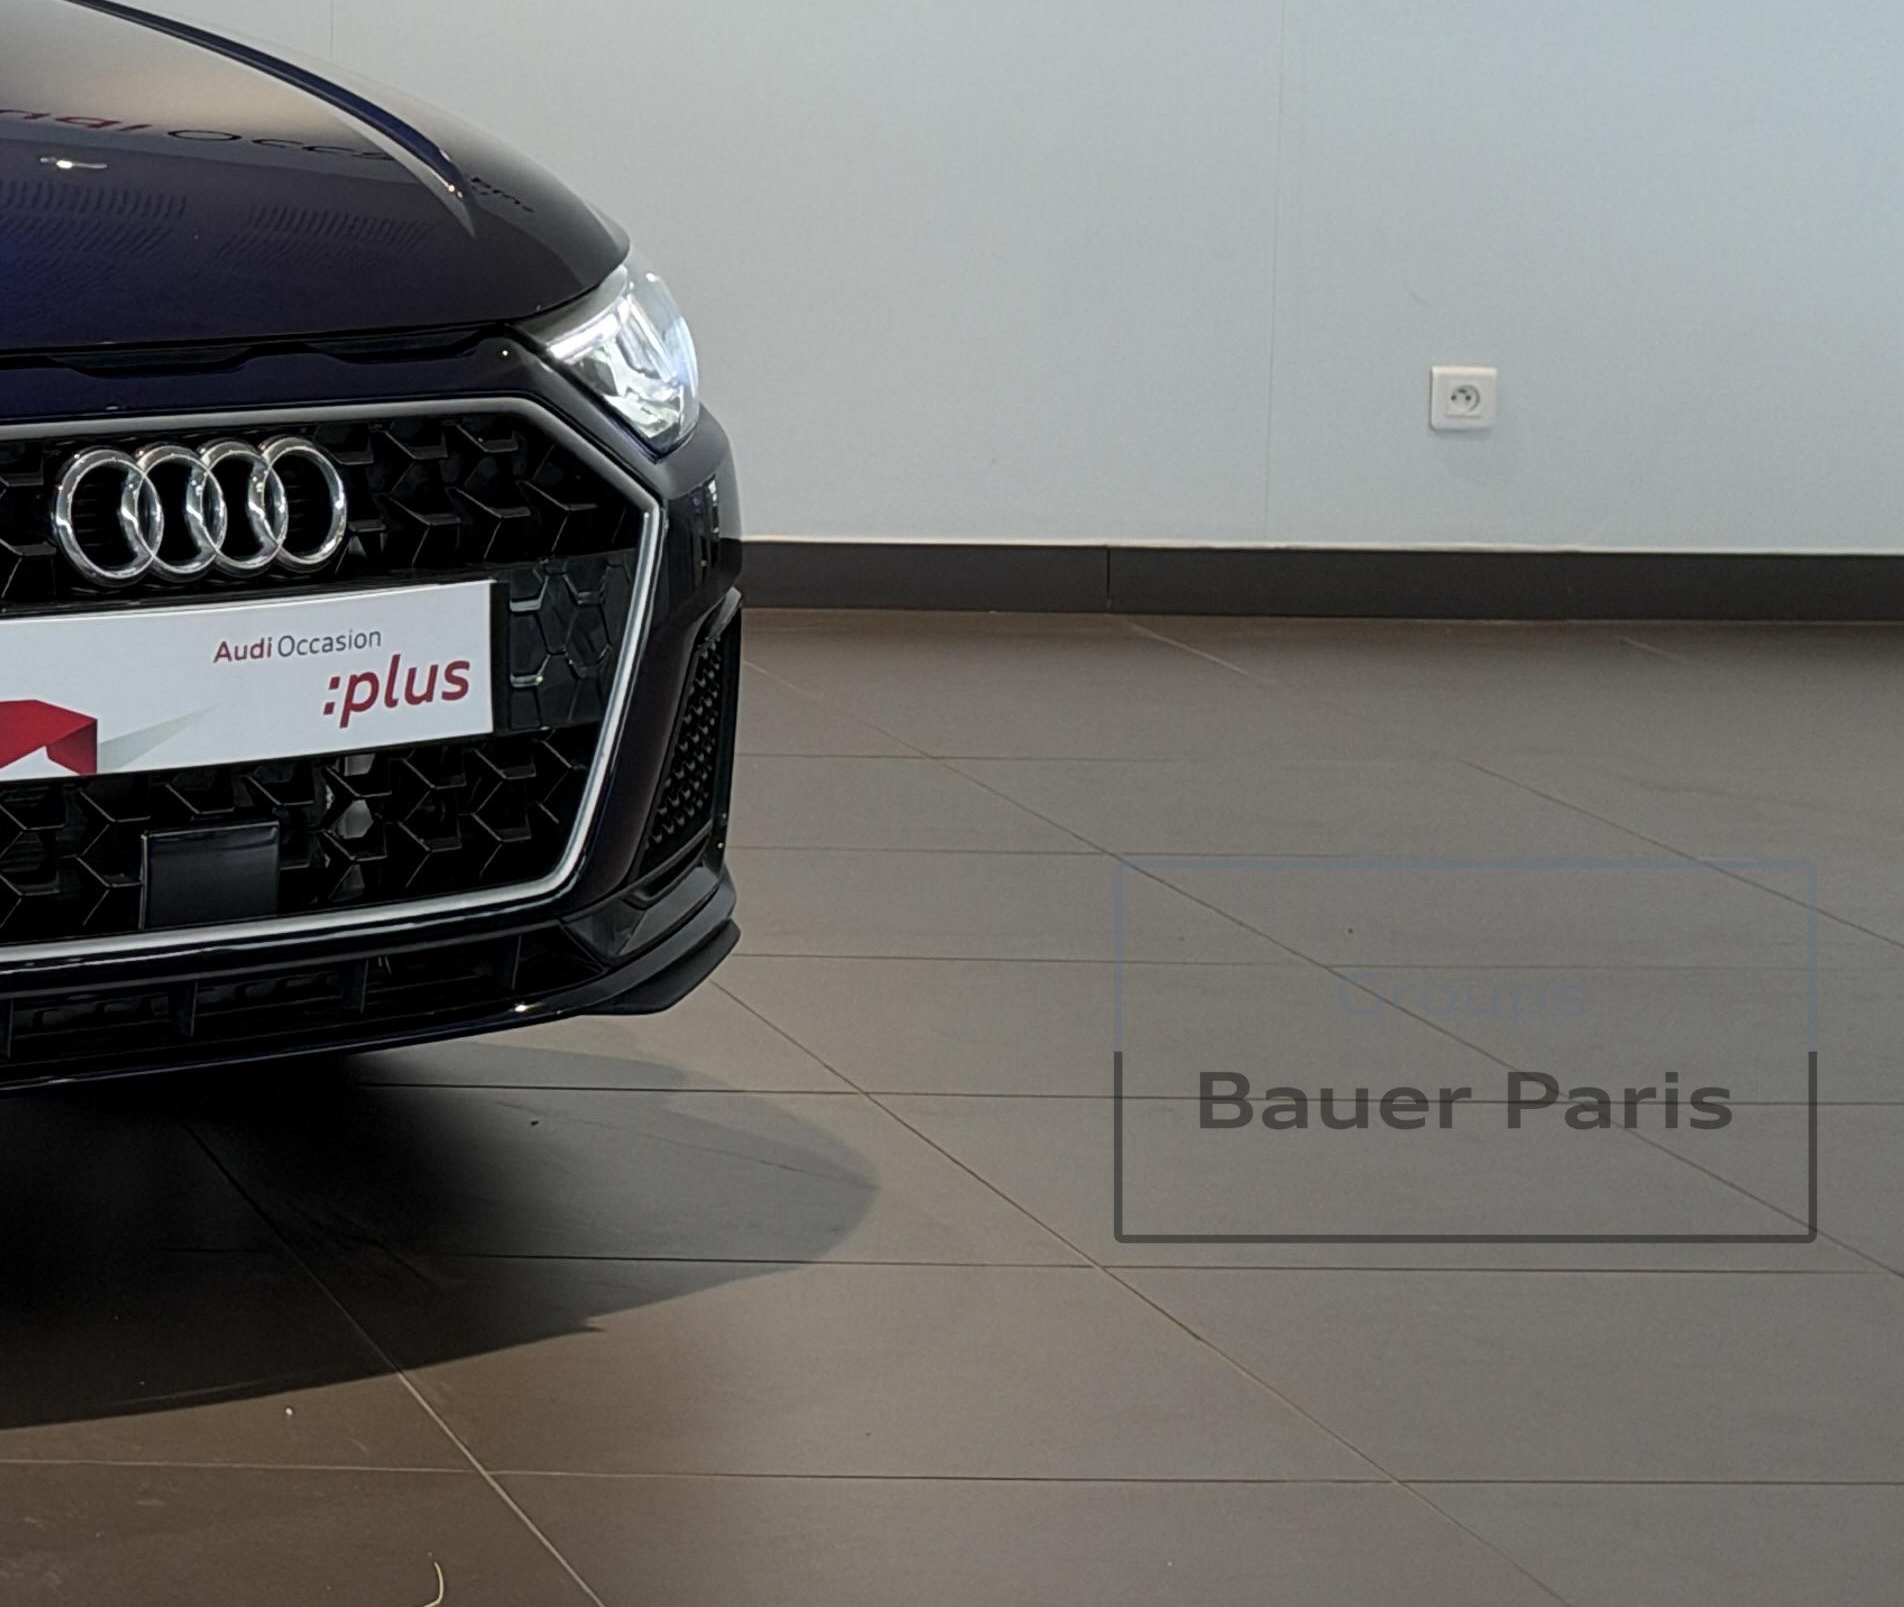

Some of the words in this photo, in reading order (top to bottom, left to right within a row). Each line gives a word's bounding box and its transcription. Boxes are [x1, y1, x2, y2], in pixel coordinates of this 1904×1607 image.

[213, 637, 273, 663] Audi
[277, 630, 382, 658] Occasion
[323, 653, 470, 729] :plus
